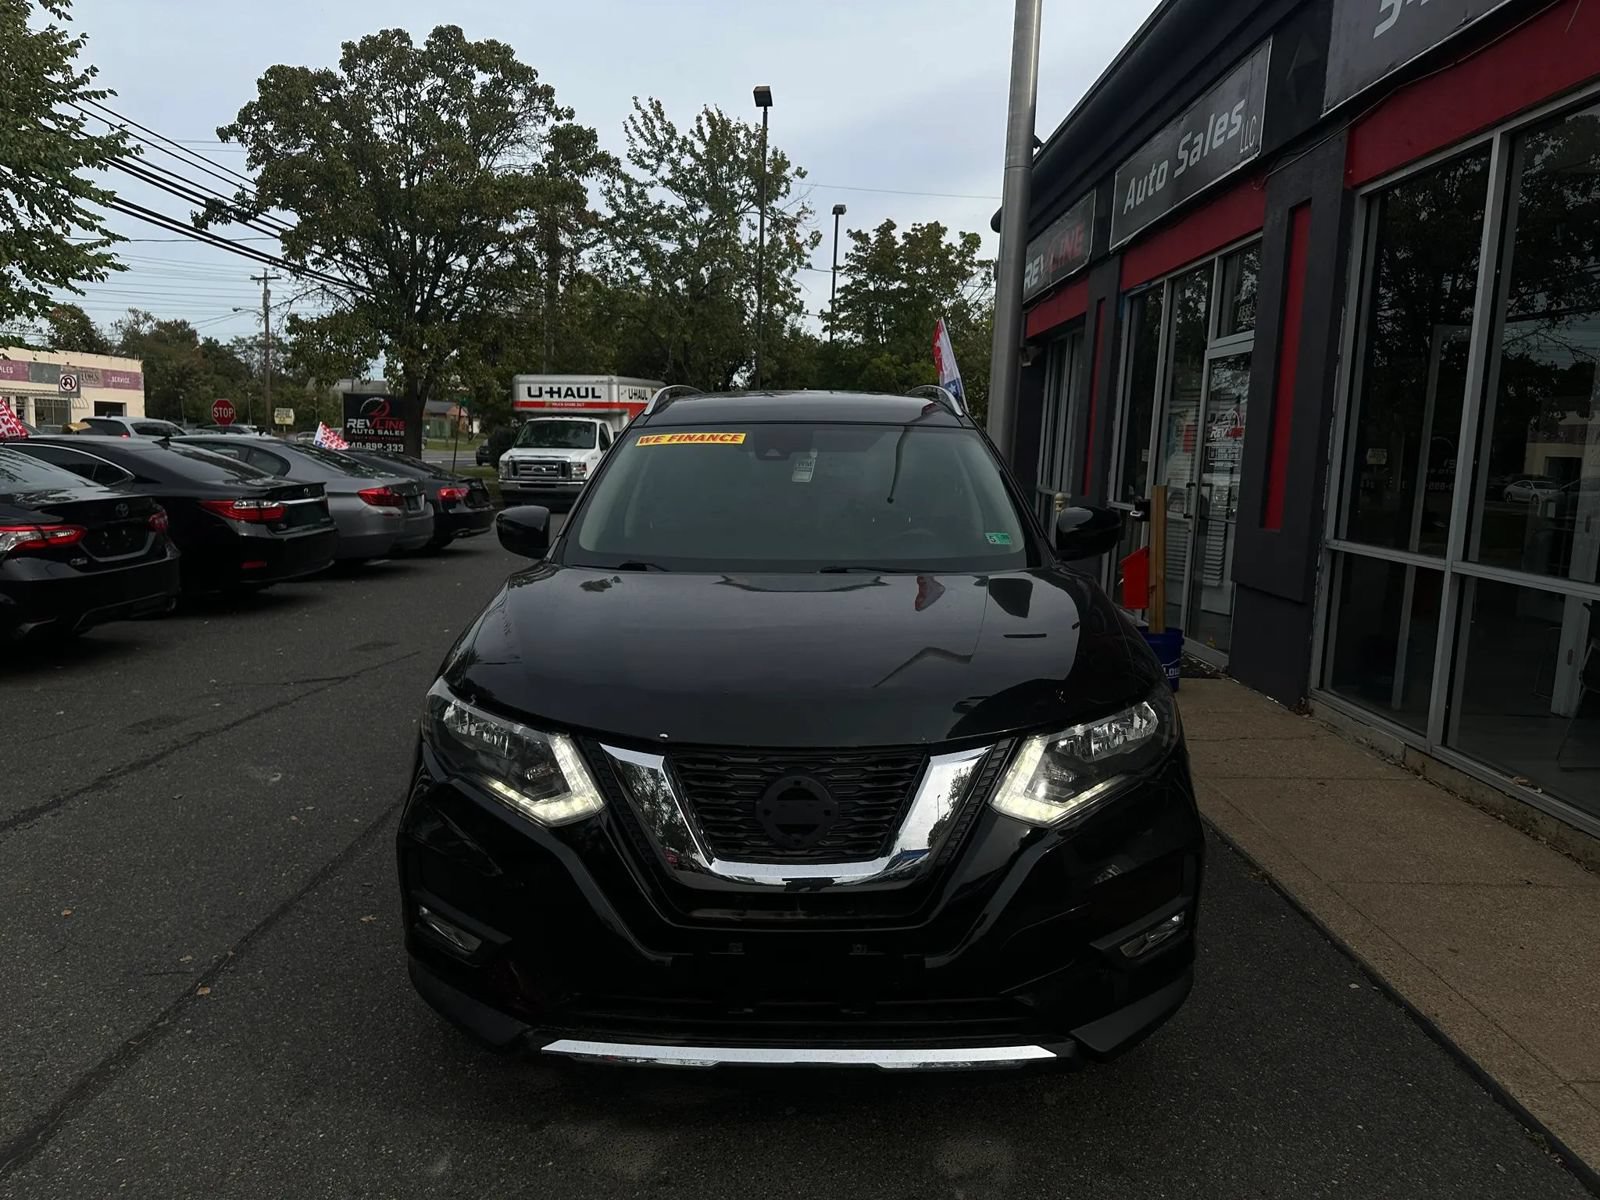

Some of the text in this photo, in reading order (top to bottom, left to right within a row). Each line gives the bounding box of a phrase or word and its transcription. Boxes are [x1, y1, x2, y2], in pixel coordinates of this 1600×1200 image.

[1239, 114, 1258, 154] LLC
[1122, 98, 1246, 215] Auto Sales
[111, 375, 131, 385] SERVICE
[526, 385, 602, 399] U-HAUL
[628, 387, 648, 400] U-HAUL
[213, 407, 234, 419] STOP
[346, 417, 407, 431] REVLINE
[351, 428, 405, 437] AUTO SALES
[639, 432, 742, 446] WE FINANCE
